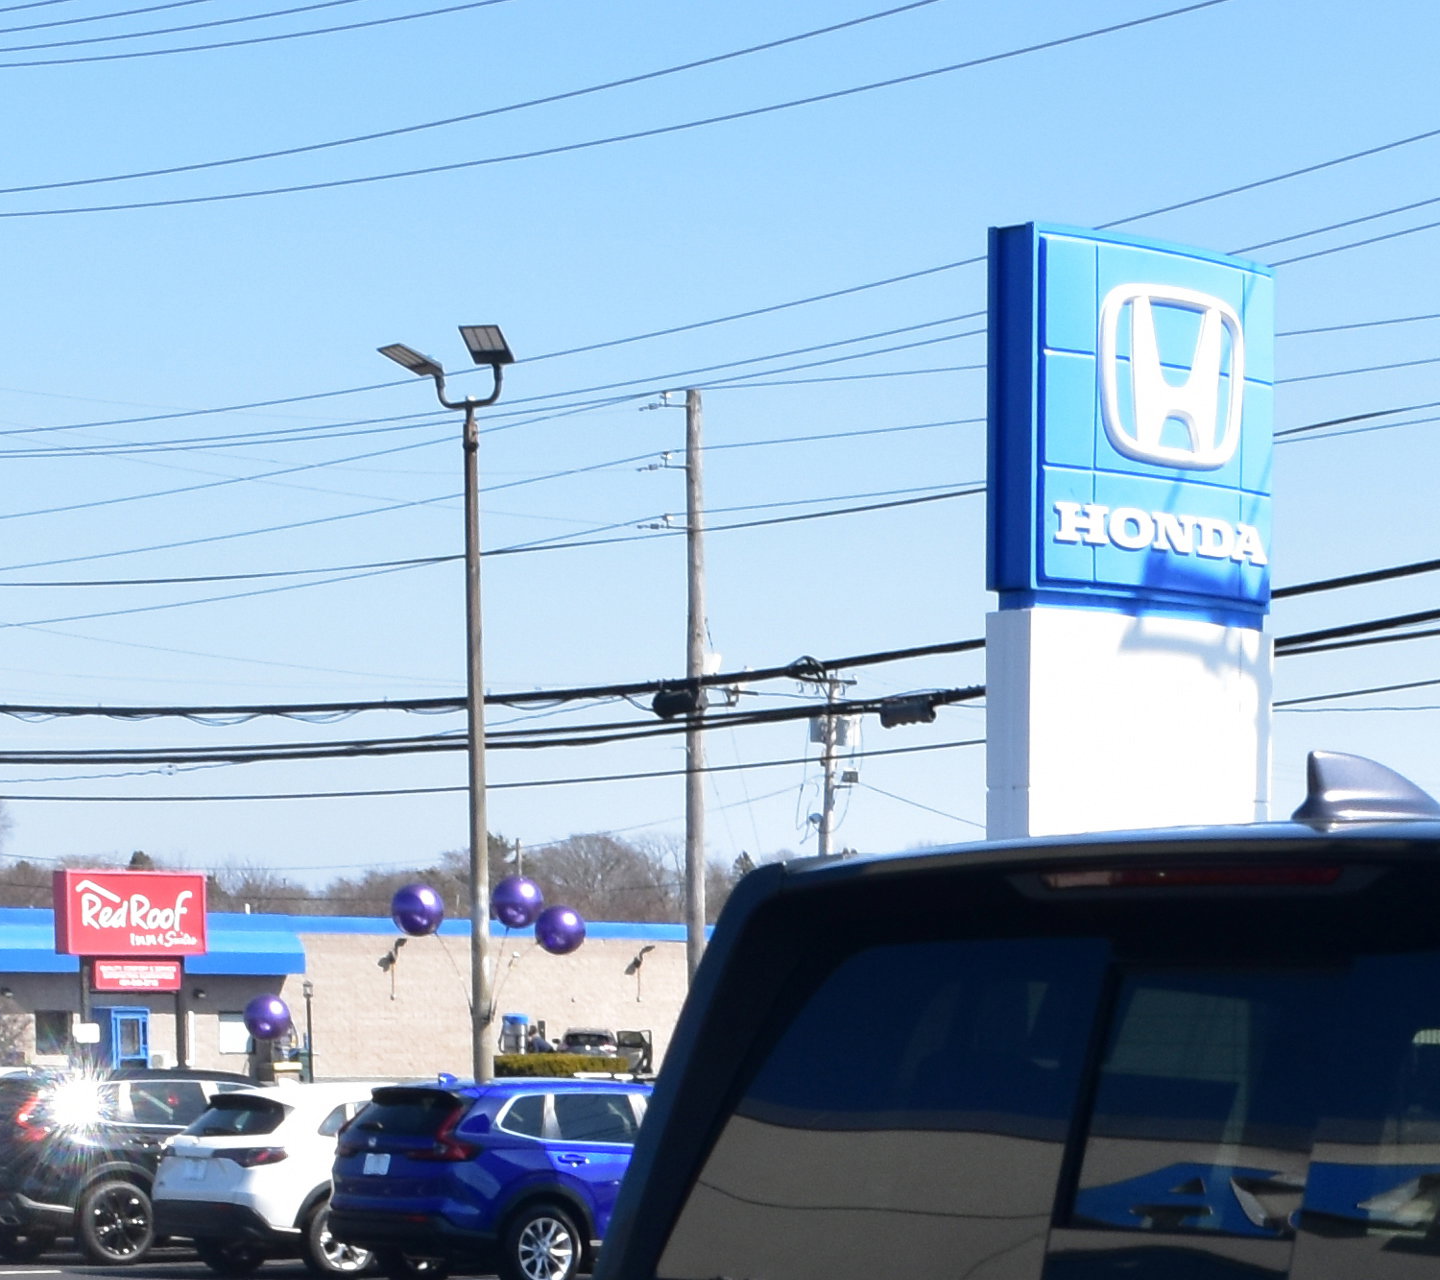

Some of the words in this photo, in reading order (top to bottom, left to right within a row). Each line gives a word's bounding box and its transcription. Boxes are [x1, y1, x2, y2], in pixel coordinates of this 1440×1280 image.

[1053, 501, 1269, 566] HONDA
[81, 892, 128, 929] Red
[130, 890, 193, 931] Roof
